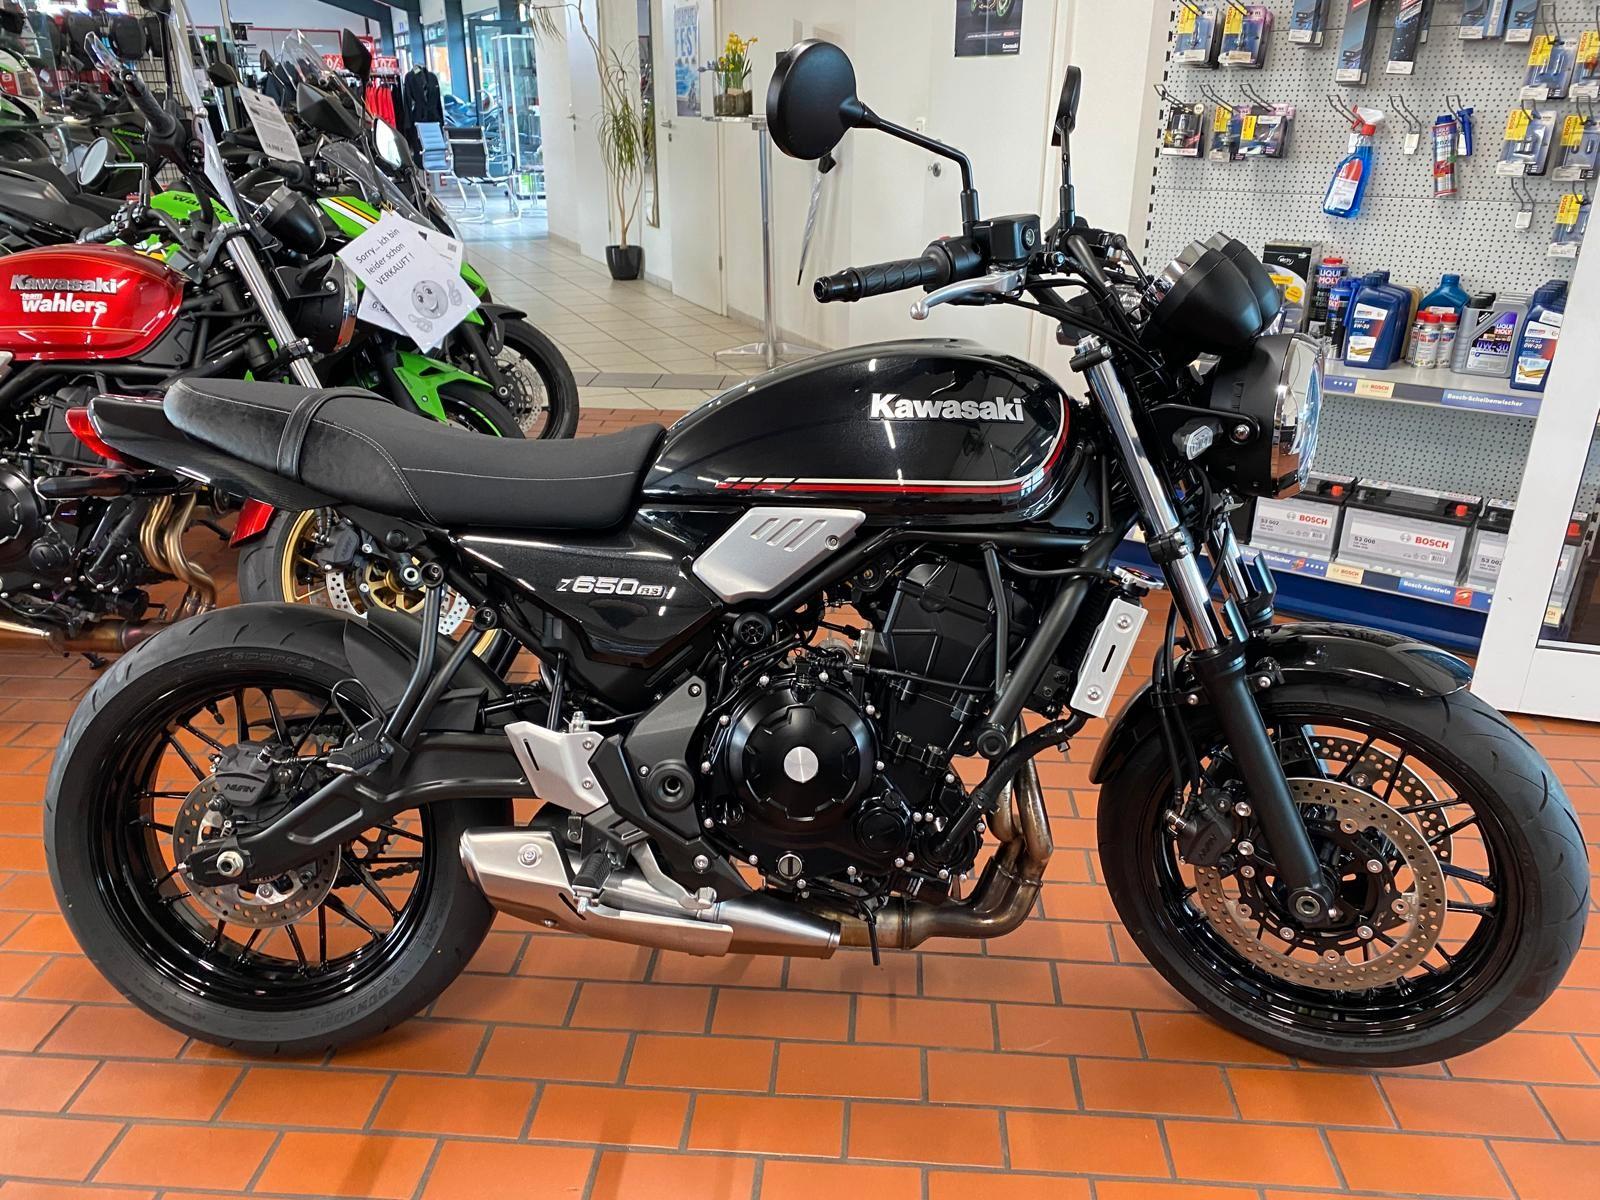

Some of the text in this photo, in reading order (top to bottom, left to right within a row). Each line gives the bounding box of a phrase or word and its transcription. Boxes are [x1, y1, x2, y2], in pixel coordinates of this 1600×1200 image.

[388, 227, 400, 241] bin
[365, 241, 406, 276] leider schon
[376, 256, 411, 286] VERKAUFT
[10, 274, 118, 294] Kawasaki
[1318, 277, 1340, 285] MOLY
[1476, 341, 1509, 351] 0W-30
[870, 392, 1025, 422] Kawasaki
[1447, 393, 1524, 407] Bosch-Scheibenwischer
[1298, 514, 1328, 526] BOSCH
[1414, 536, 1449, 550] BOSCH
[1340, 569, 1359, 577] BOSCH
[1403, 581, 1451, 595] Bosch Aerotwin
